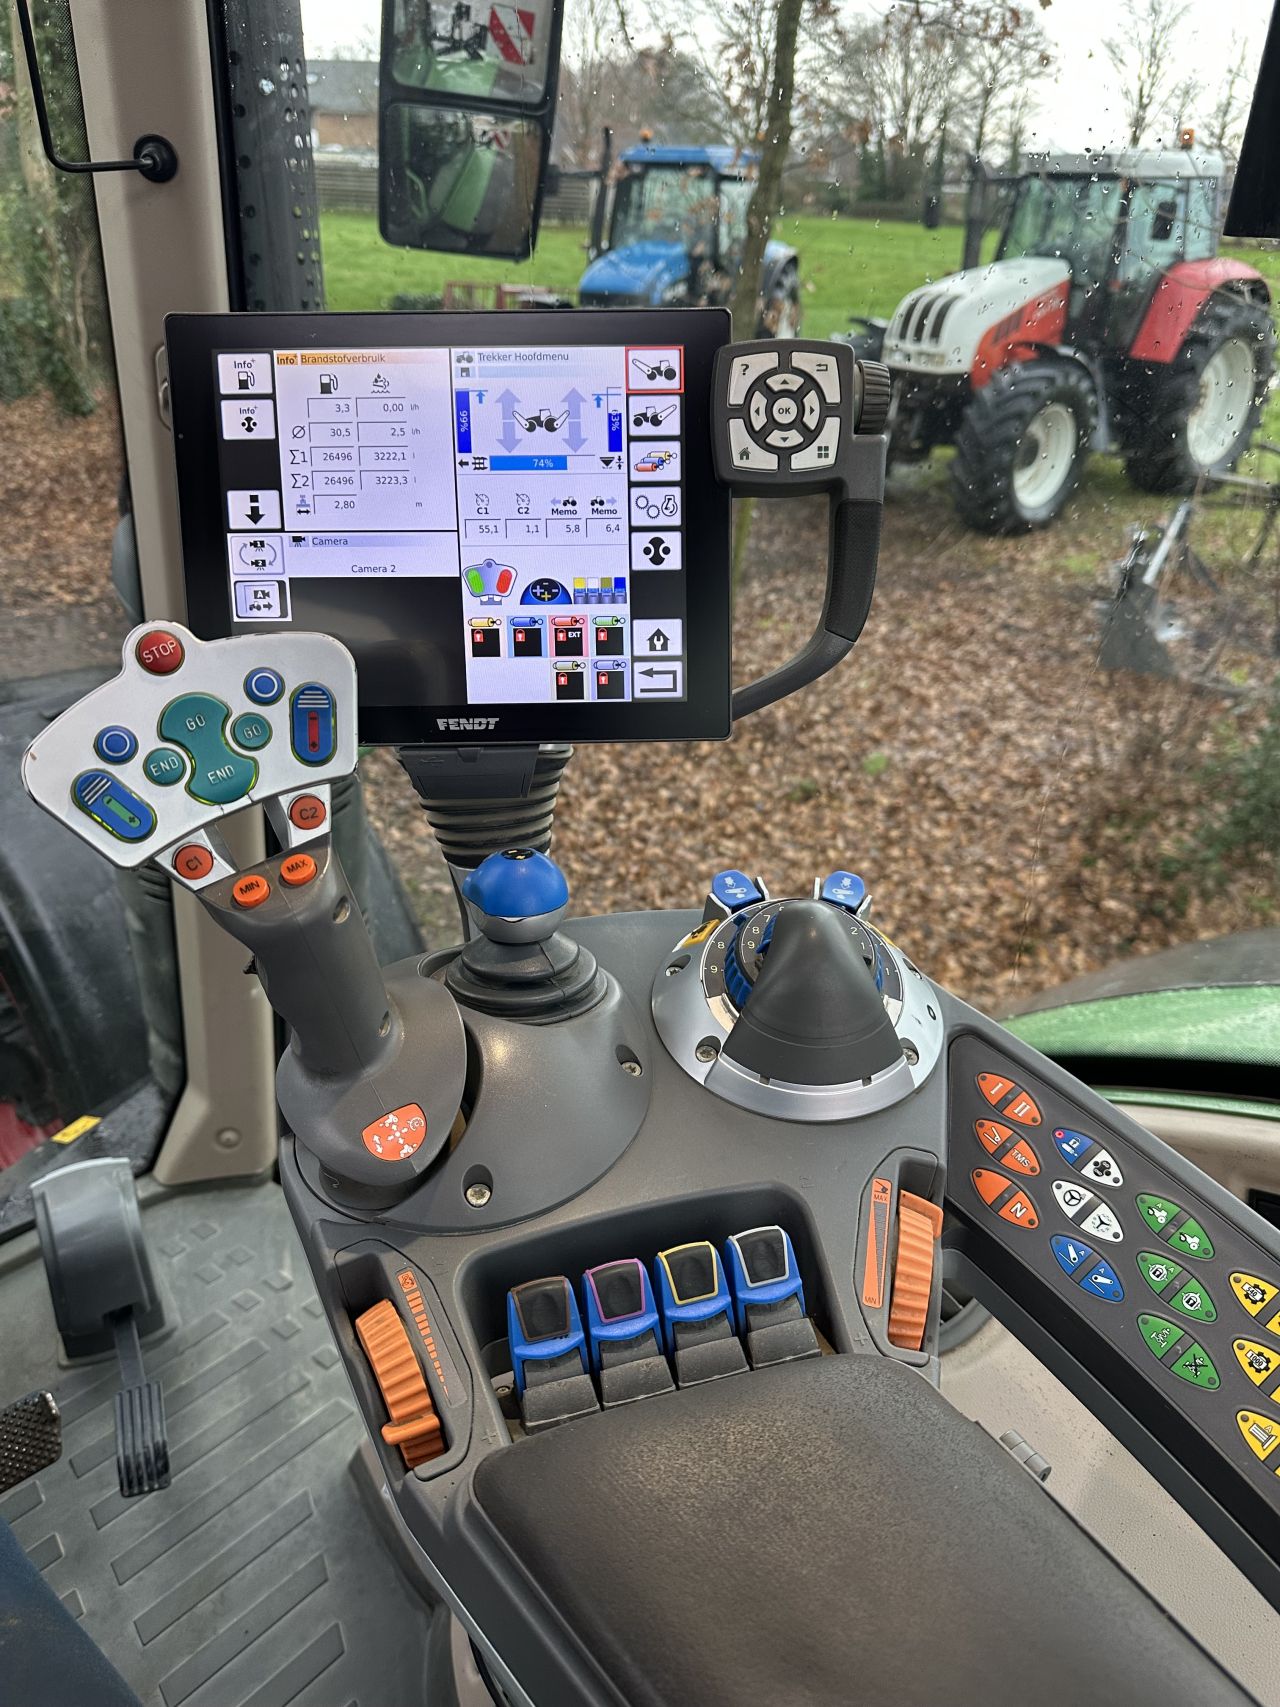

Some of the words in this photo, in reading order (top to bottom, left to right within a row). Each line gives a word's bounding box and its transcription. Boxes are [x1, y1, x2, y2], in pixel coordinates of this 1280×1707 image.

[301, 354, 386, 364] Brandstofverbruik
[478, 352, 512, 361] Trekker
[515, 352, 569, 361] Hoofdmenu
[335, 404, 350, 414] 3,3
[383, 404, 404, 413] 0,00
[778, 407, 791, 415] OK
[330, 428, 351, 438] 30,5
[391, 428, 406, 438] 2,5
[323, 452, 353, 462] 26496
[374, 452, 407, 462] 3222,1
[533, 459, 554, 468] 74%
[324, 476, 354, 486] 26496
[375, 476, 408, 486] 3223,3
[334, 500, 355, 510] 2,80
[476, 507, 489, 515] C1
[517, 507, 530, 515] C2
[551, 508, 578, 516] Memo
[591, 507, 618, 515] Memo
[479, 524, 499, 534] 55,1
[526, 524, 540, 534] 1,1
[566, 524, 580, 533] 5,8
[606, 524, 620, 533] 6,4
[312, 537, 348, 546] Camera
[351, 564, 388, 573] Camera
[391, 564, 396, 573] 2
[142, 640, 178, 664] STOP
[186, 713, 206, 731] GO
[436, 718, 500, 731] FENDT
[243, 724, 262, 739] GO
[150, 756, 179, 776] END
[207, 764, 235, 785] END
[299, 806, 318, 821] C2
[185, 856, 203, 871] C1
[286, 857, 308, 874] MAX
[239, 880, 260, 895] MIN
[764, 914, 771, 923] 7
[752, 926, 759, 934] 8
[850, 927, 858, 935] 2
[717, 941, 725, 949] 8
[747, 941, 755, 949] 9
[710, 965, 718, 973] 9
[1011, 1149, 1031, 1167] TMS
[873, 1193, 888, 1202] MAX
[1010, 1201, 1027, 1218] N
[1247, 1286, 1258, 1297] 540
[864, 1297, 877, 1305] MIN
